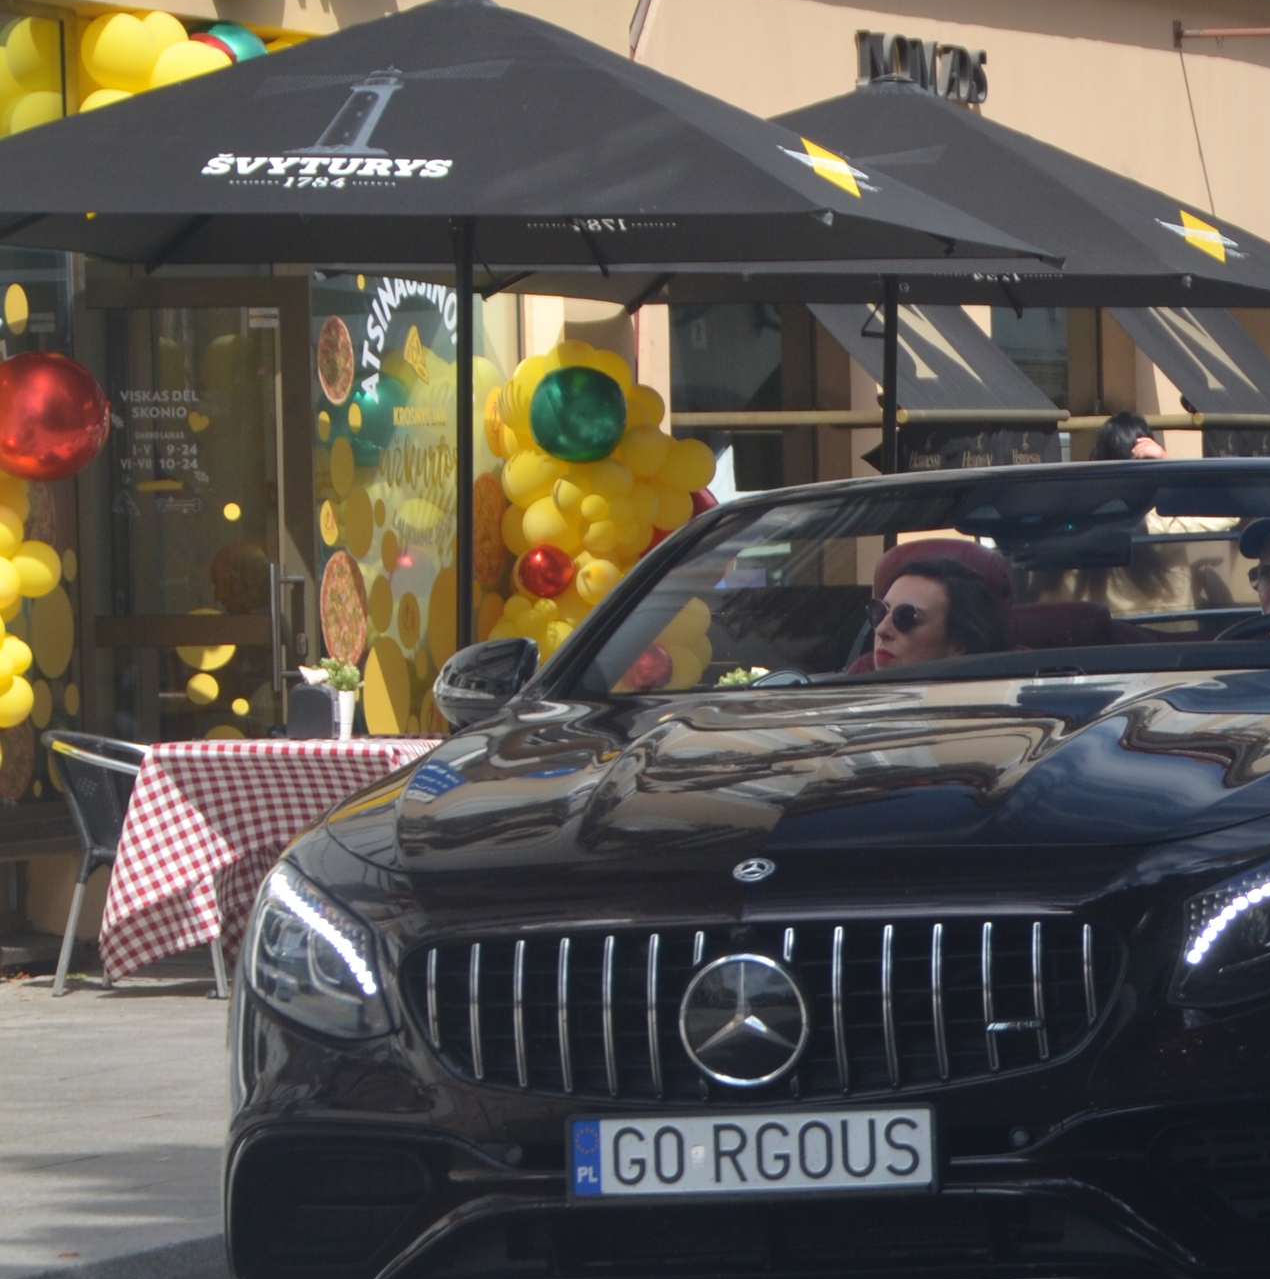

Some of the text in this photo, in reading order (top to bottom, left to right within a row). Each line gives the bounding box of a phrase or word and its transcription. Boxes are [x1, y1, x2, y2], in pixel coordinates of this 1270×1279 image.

[201, 153, 453, 178] ŠVYTURYS
[282, 175, 347, 190] 1784
[120, 389, 169, 402] VISKAS
[132, 406, 187, 419] SKONIO
[613, 1116, 921, 1186] GO RGOUS
[577, 1165, 599, 1184] PL
